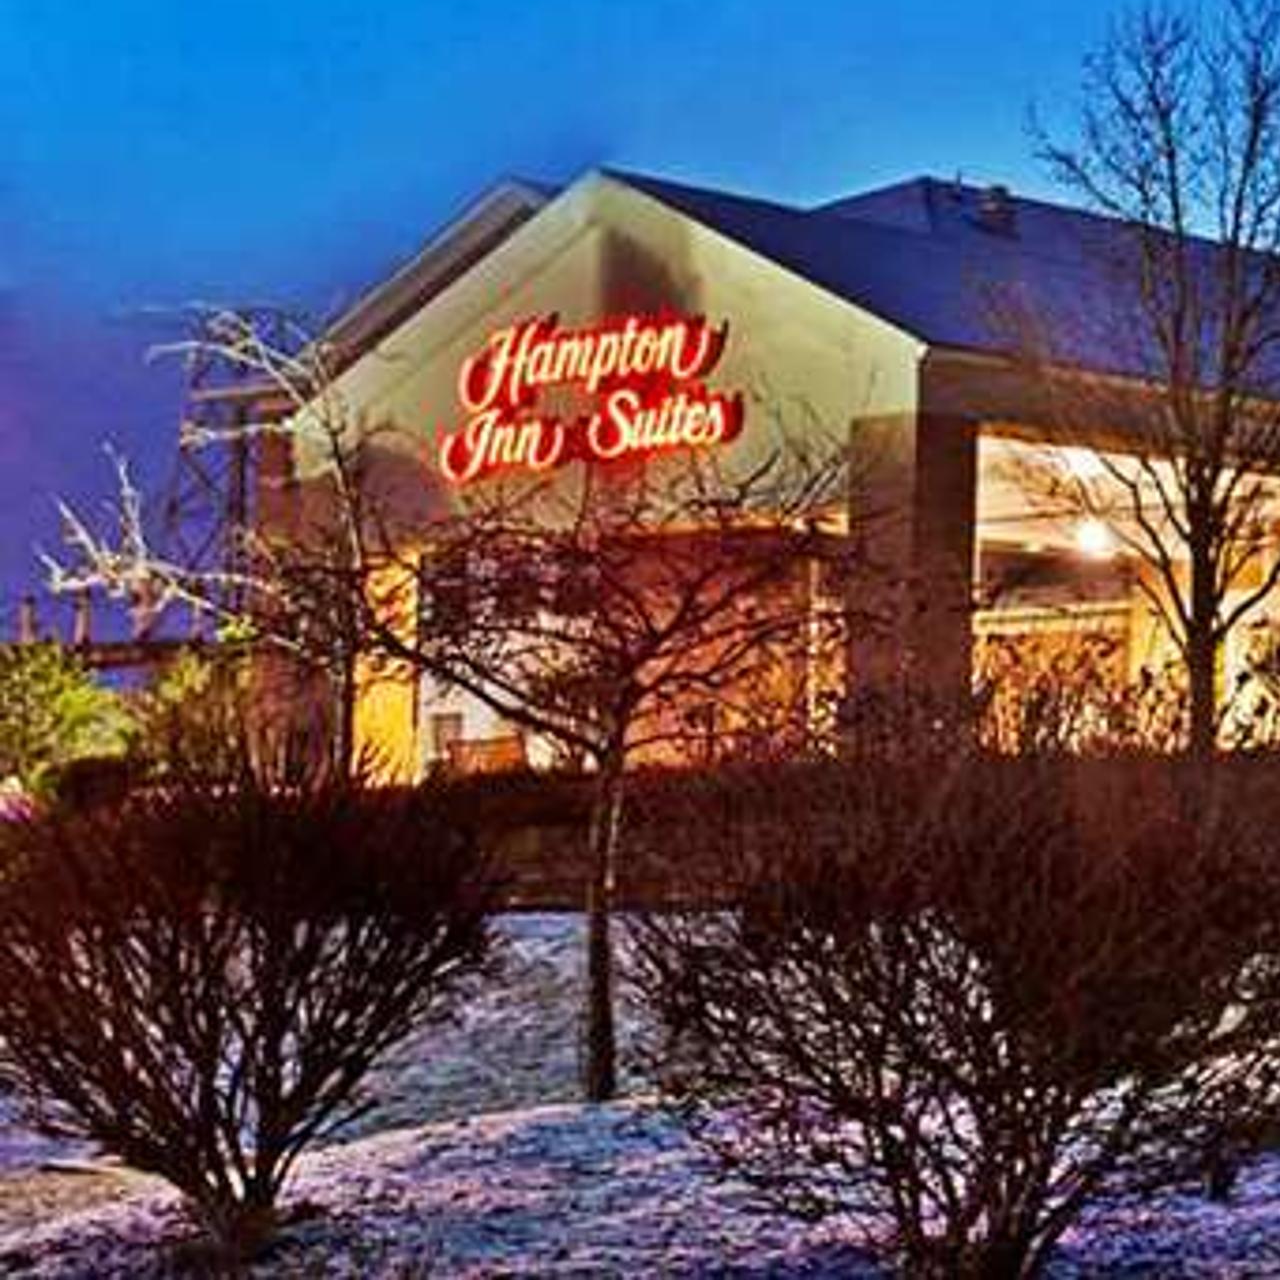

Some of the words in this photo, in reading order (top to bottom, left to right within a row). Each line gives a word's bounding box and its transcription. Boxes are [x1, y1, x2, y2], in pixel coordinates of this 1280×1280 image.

[458, 317, 711, 412] Hampton
[440, 407, 564, 481] Inn
[587, 389, 725, 459] Suites
